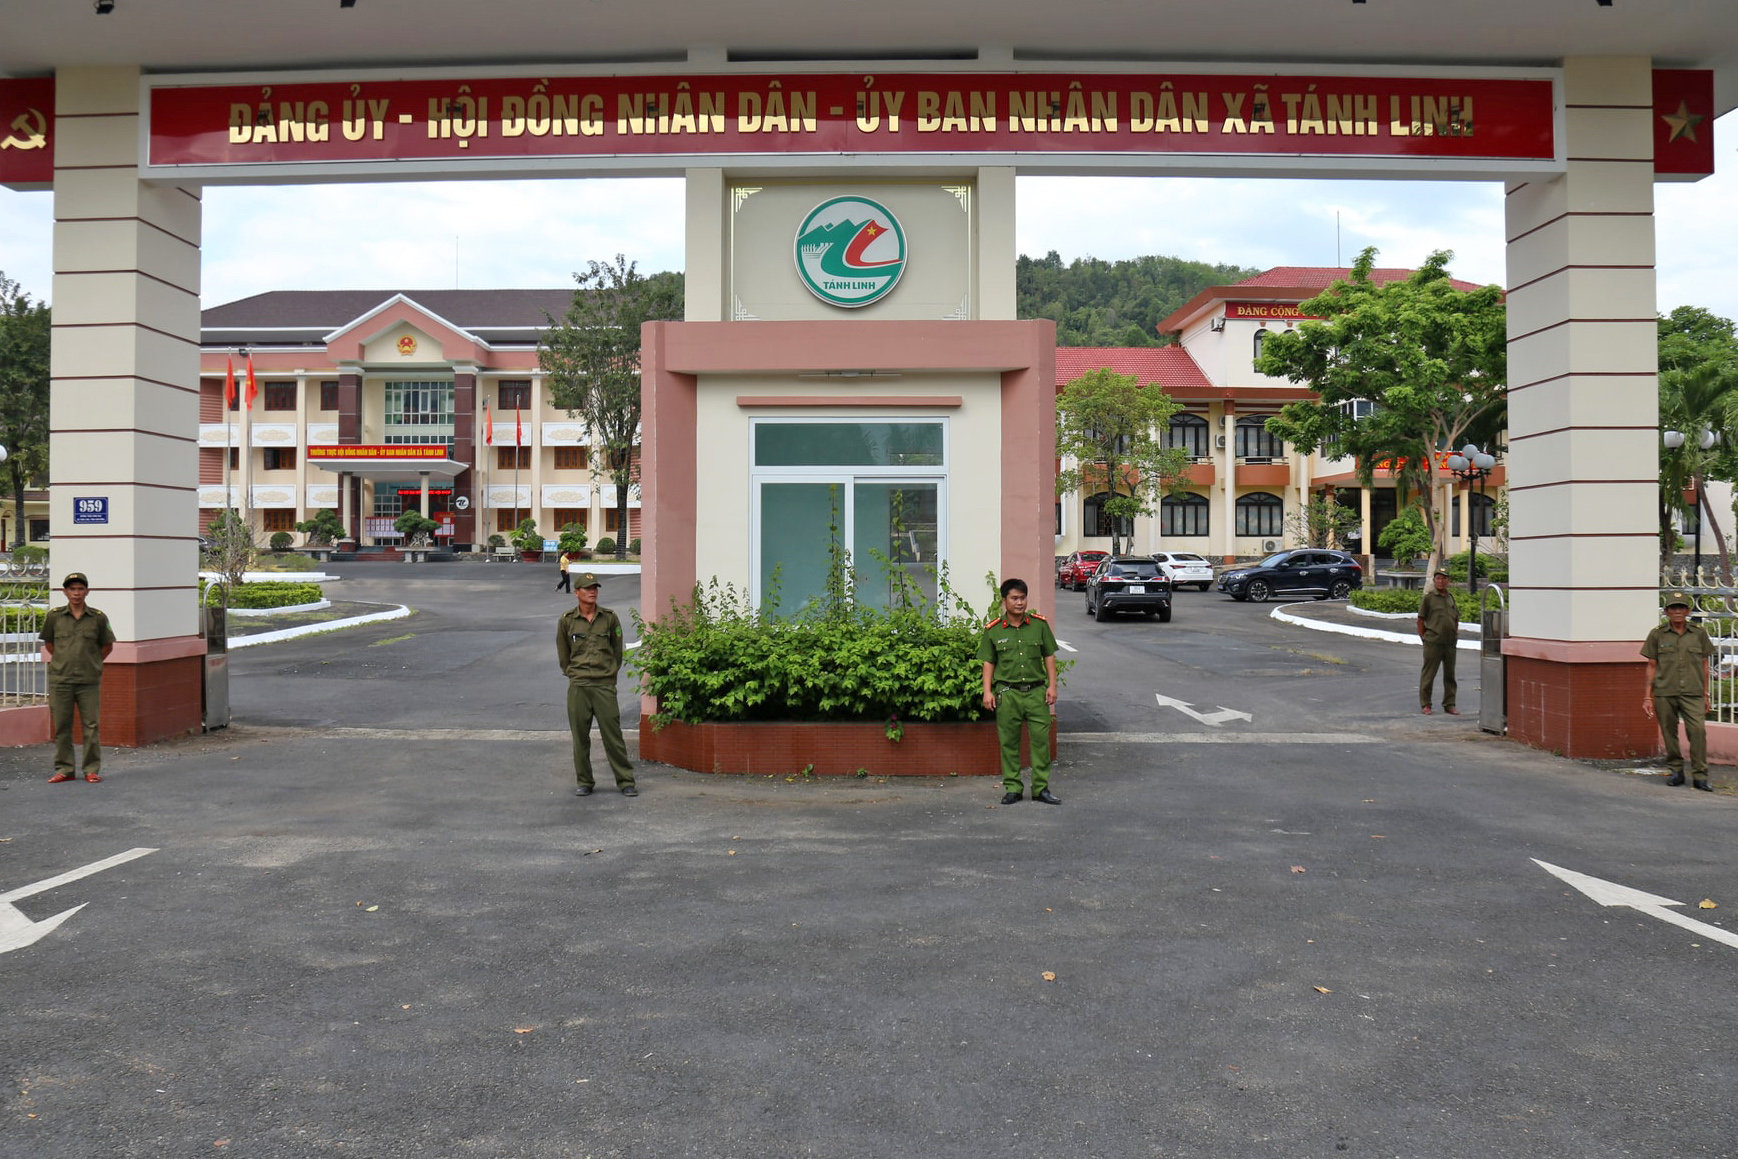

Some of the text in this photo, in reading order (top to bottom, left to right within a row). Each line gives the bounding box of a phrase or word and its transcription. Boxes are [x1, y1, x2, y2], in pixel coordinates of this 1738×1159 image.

[229, 86, 329, 143] ĐẢNG
[342, 84, 390, 141] ỦY
[427, 85, 488, 148] HỘI
[501, 78, 604, 137] ĐỒNG
[617, 81, 725, 135] NHÂN
[738, 80, 817, 133] DÂN
[856, 75, 905, 133] ỦY
[917, 91, 997, 133] BAN
[1008, 81, 1118, 133] NHÂN
[1130, 81, 1209, 133] DÂN
[1221, 84, 1275, 134] XÃ
[1281, 84, 1378, 136] TÁNH
[1389, 95, 1474, 137] LINH
[823, 279, 876, 290] TÁNH LINH
[1270, 305, 1299, 318] CỘNG
[79, 499, 103, 513] 959
